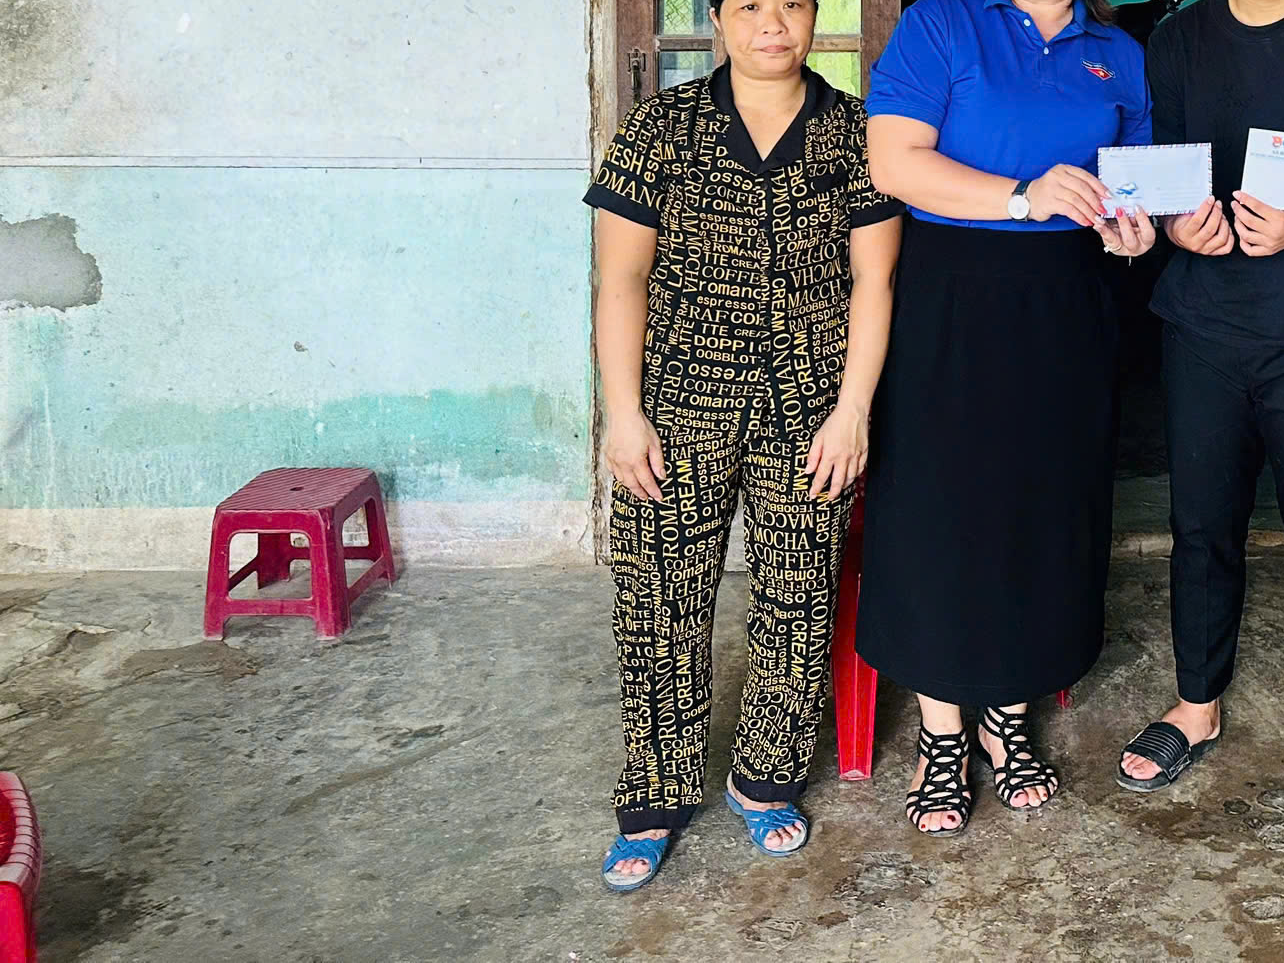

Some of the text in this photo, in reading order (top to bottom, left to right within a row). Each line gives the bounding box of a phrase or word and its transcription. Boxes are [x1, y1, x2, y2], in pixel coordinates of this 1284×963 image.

[699, 212, 759, 226] espresso
[683, 233, 703, 293] MOCHA
[688, 305, 729, 323] RAF
[697, 295, 756, 311] espresso
[771, 278, 787, 332] CREAM
[793, 330, 817, 396] CREAM
[683, 378, 754, 396] COFFEE
[772, 333, 804, 433] ROMANO
[675, 406, 733, 420] espresso
[679, 392, 746, 408] romano
[671, 444, 696, 461] RAF
[748, 439, 793, 457] LACE
[676, 459, 698, 525] CREAM
[754, 525, 810, 551] MOCHA
[754, 543, 827, 569] COFFEE
[806, 588, 829, 681] ROMANO
[790, 620, 808, 679] CREAM
[676, 652, 694, 710] CREAM
[655, 658, 677, 740] ROMANO
